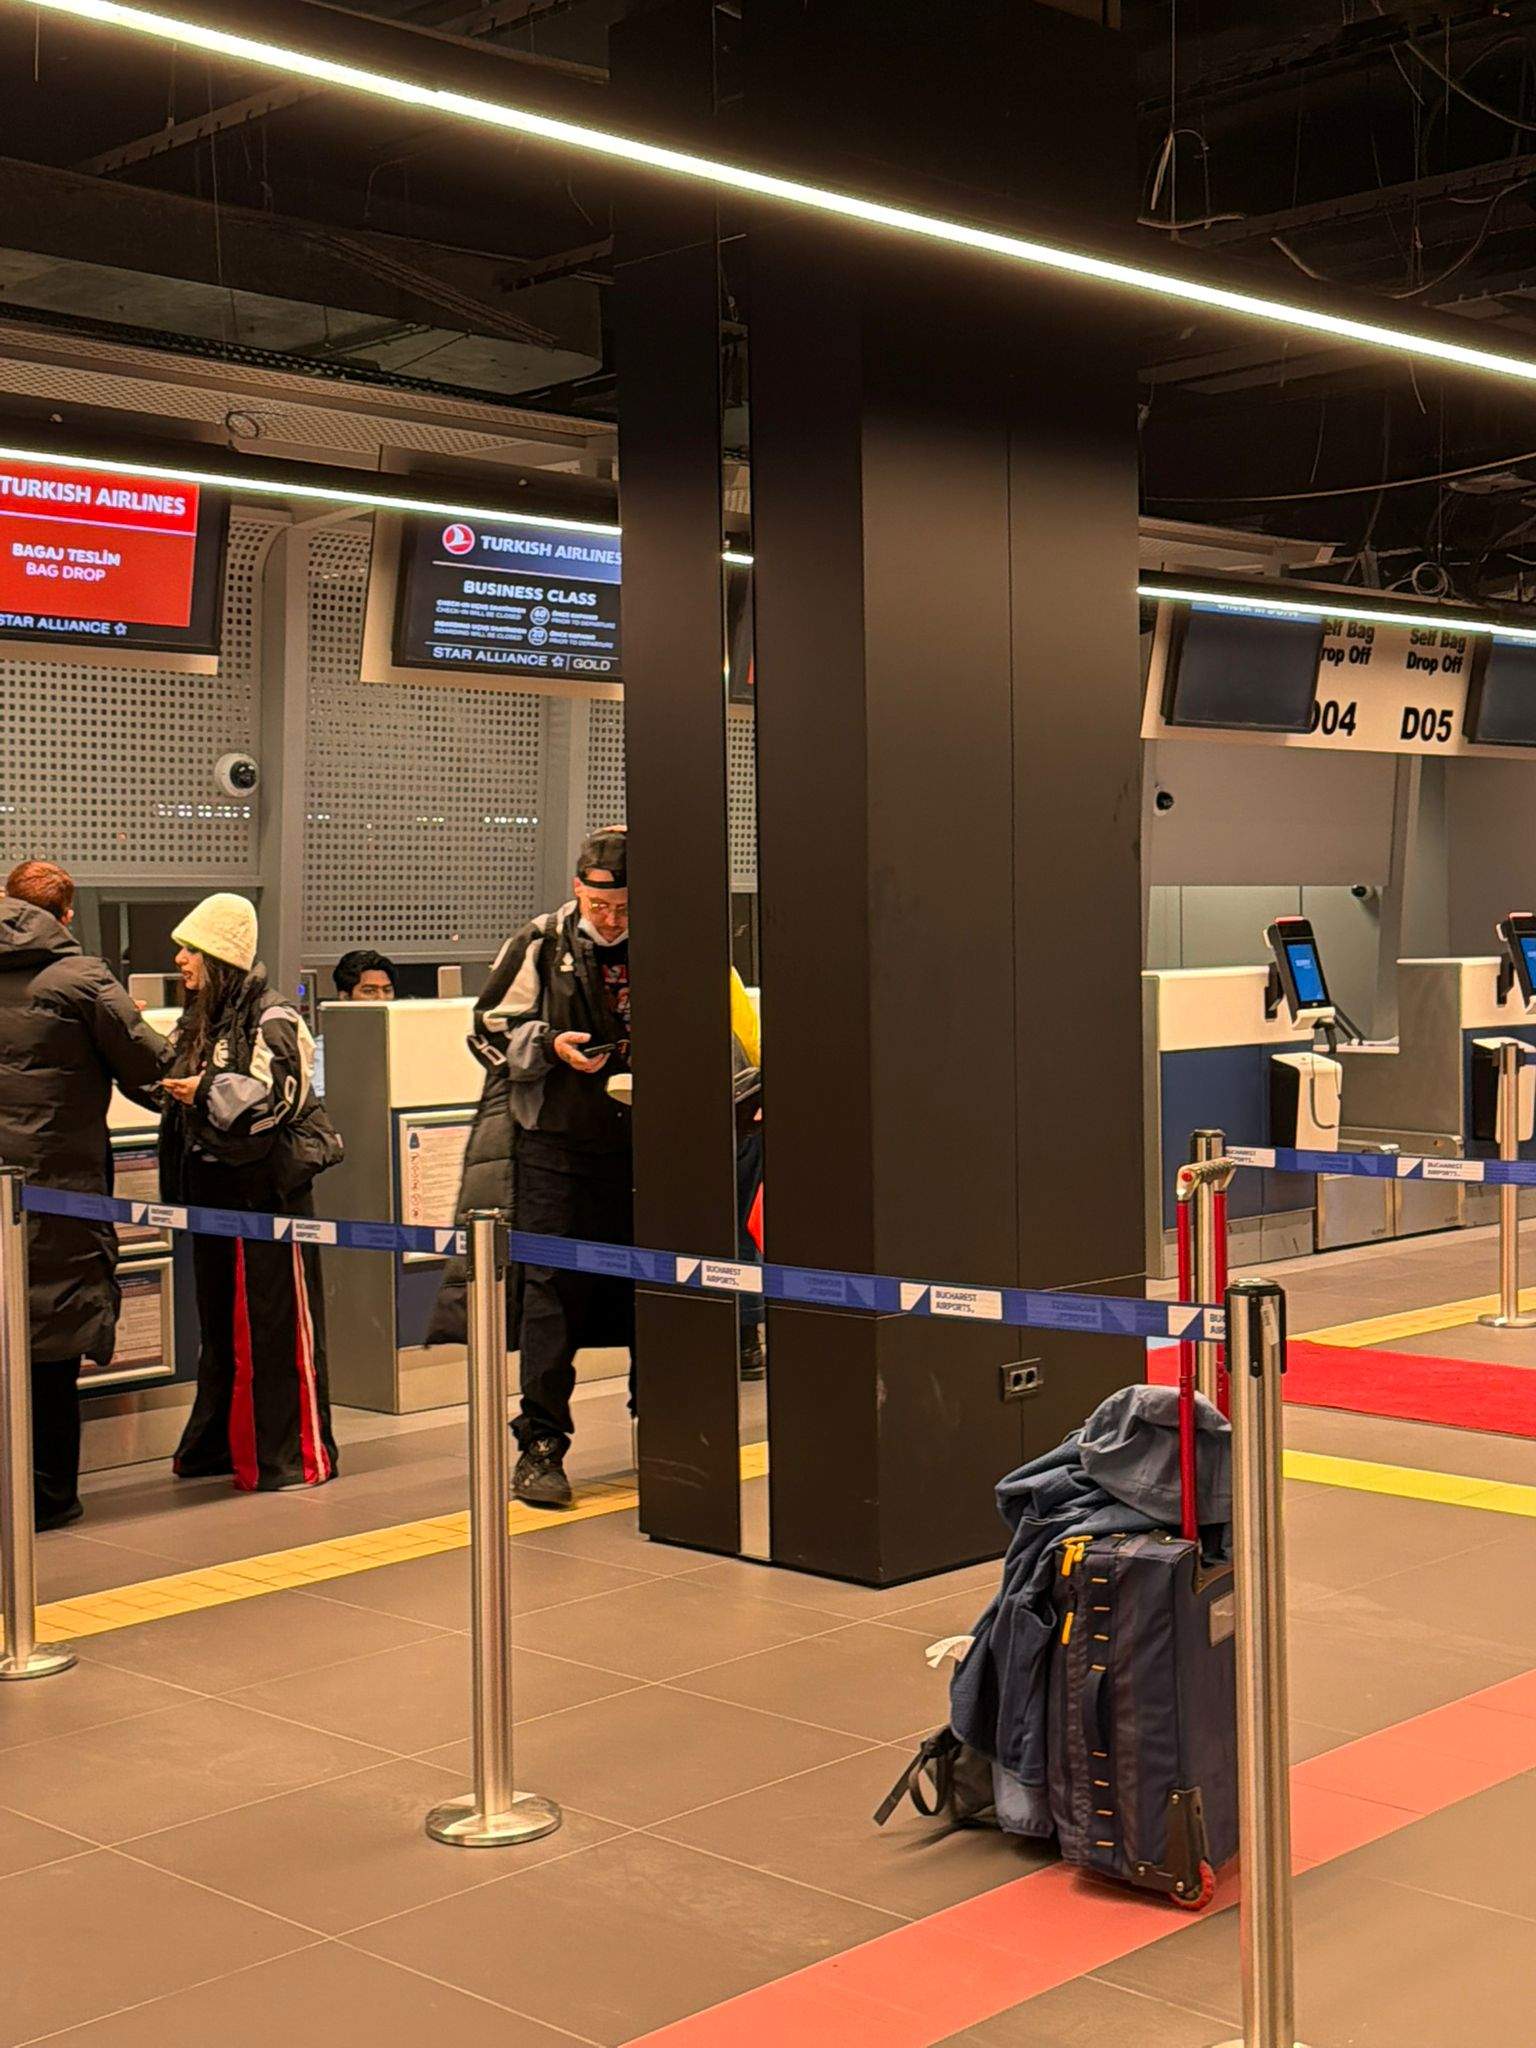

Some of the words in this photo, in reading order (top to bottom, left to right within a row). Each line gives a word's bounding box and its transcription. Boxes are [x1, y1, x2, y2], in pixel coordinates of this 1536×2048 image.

[0, 475, 91, 504] TURKISH
[96, 487, 186, 516] AIRLINES
[12, 542, 64, 561] BAGAJ
[67, 548, 121, 566] TESLİM
[480, 535, 551, 557] TURKISH
[554, 545, 622, 565] AIRLINES
[26, 562, 59, 578] BAG
[62, 565, 106, 582] DROP
[463, 579, 544, 601] BUSINESS
[547, 589, 597, 606] CLASS
[0, 613, 33, 628] STAR
[37, 617, 111, 634] ALLIANCE
[1322, 619, 1343, 637] elf
[1346, 620, 1375, 645] Bag
[1410, 627, 1437, 647] Self
[1440, 630, 1466, 654] Bag
[433, 646, 472, 661] STAR
[475, 650, 548, 667] ALLIANCE
[573, 657, 611, 671] GOLD
[1320, 647, 1345, 667] rop
[1349, 645, 1372, 666] Off
[1406, 651, 1438, 676] Drop
[1441, 654, 1463, 674] Off
[1400, 706, 1453, 743] D05
[706, 1264, 742, 1276] BUCHAREST
[935, 1290, 977, 1302] BUCHAREST
